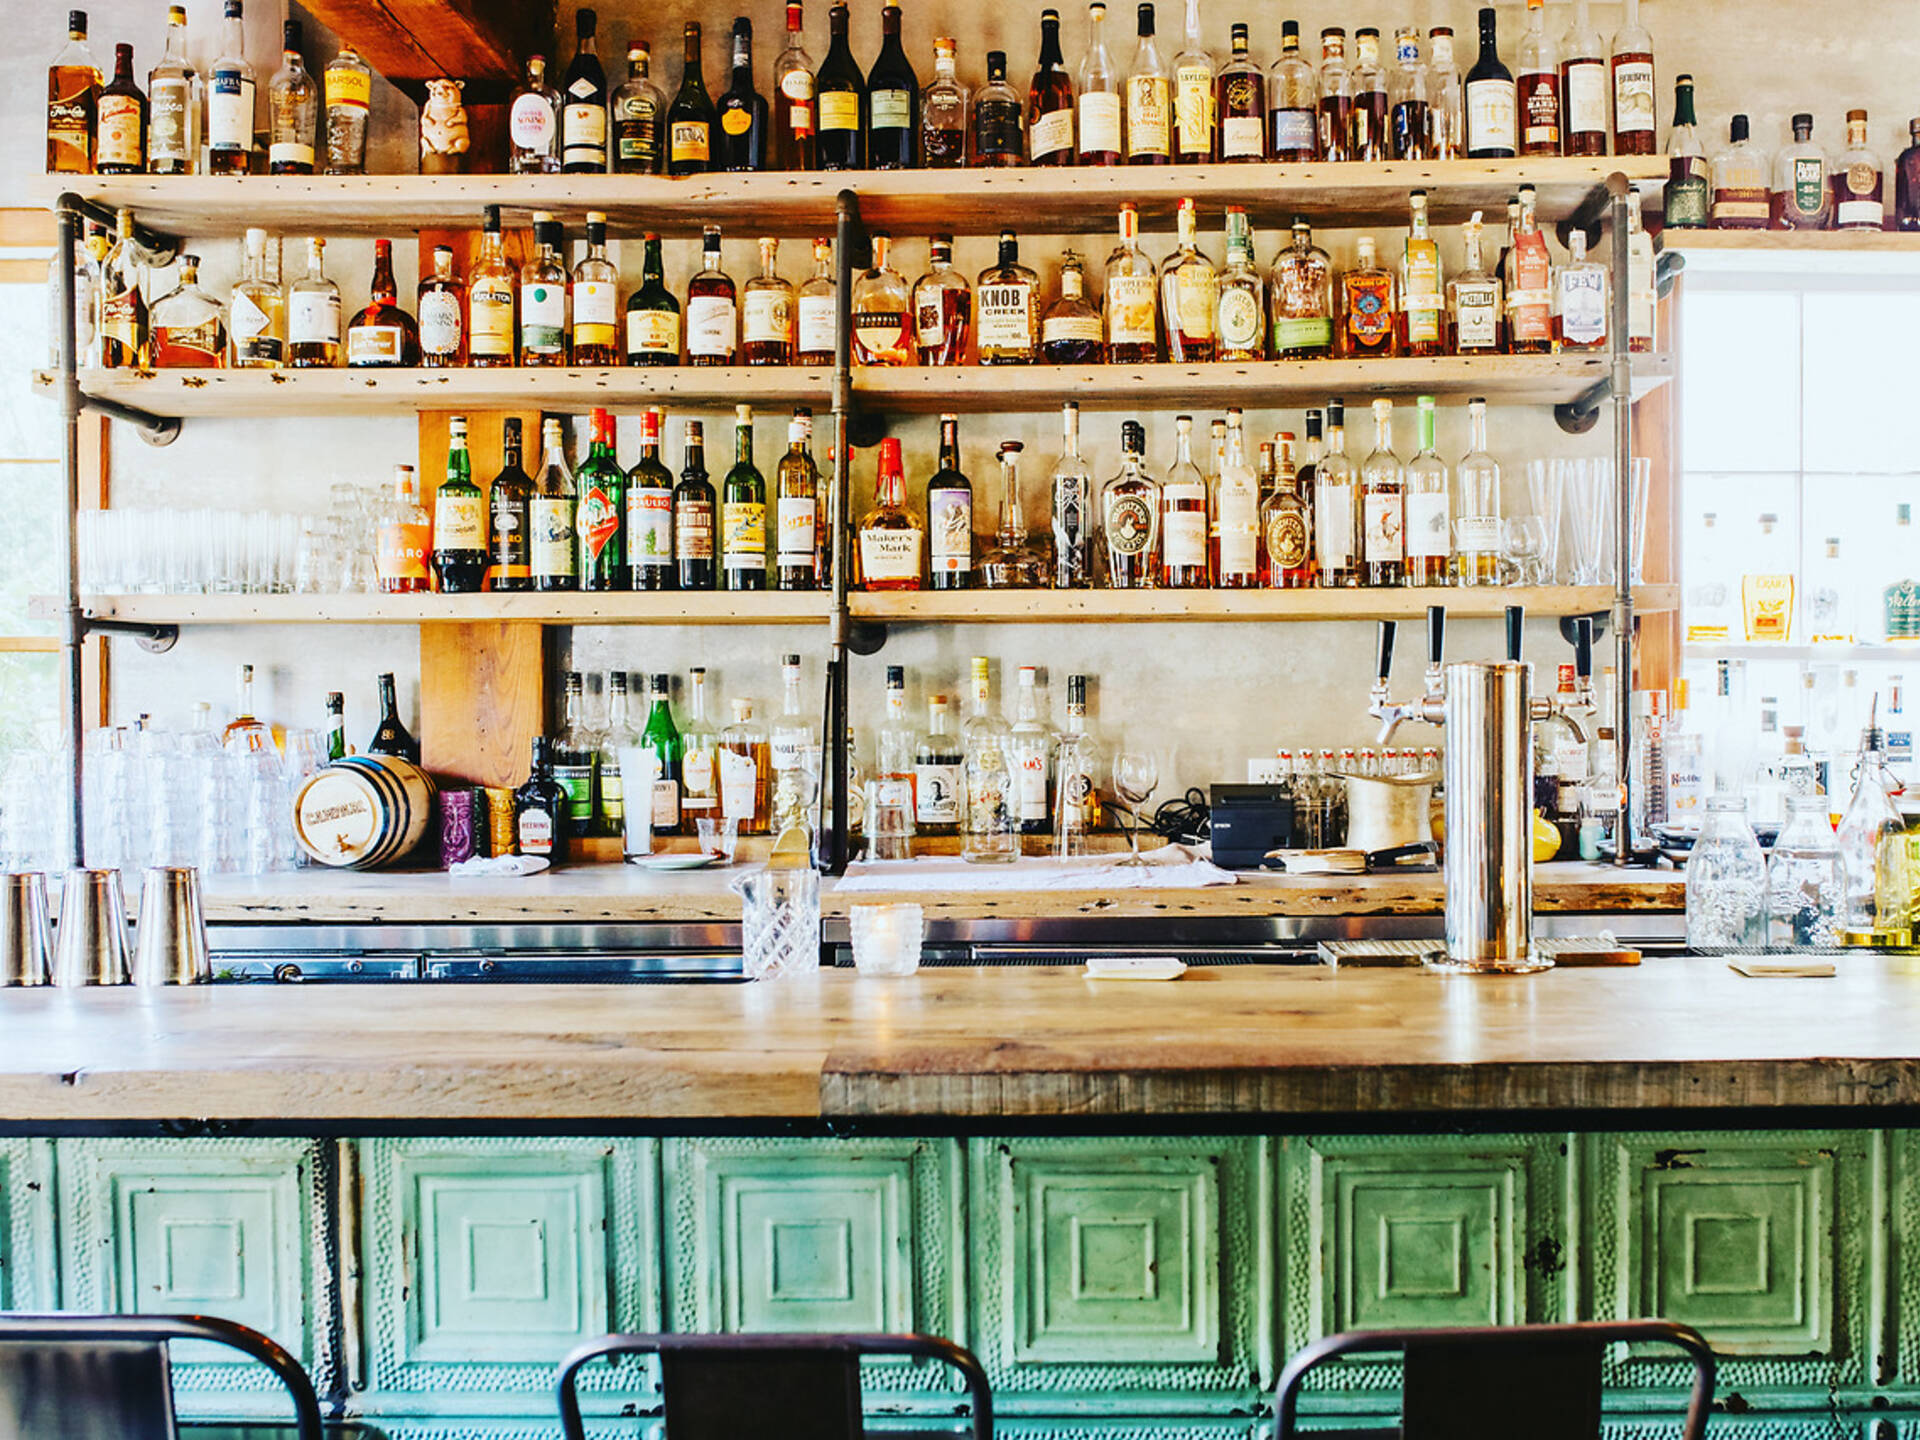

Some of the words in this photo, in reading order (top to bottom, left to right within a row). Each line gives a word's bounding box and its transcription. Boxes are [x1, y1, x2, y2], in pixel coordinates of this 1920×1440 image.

[980, 289, 1021, 307] KNOB
[985, 308, 1026, 316] CREEK
[865, 533, 912, 543] Maker's
[879, 543, 912, 553] Mark
[521, 822, 549, 830] HEERING
